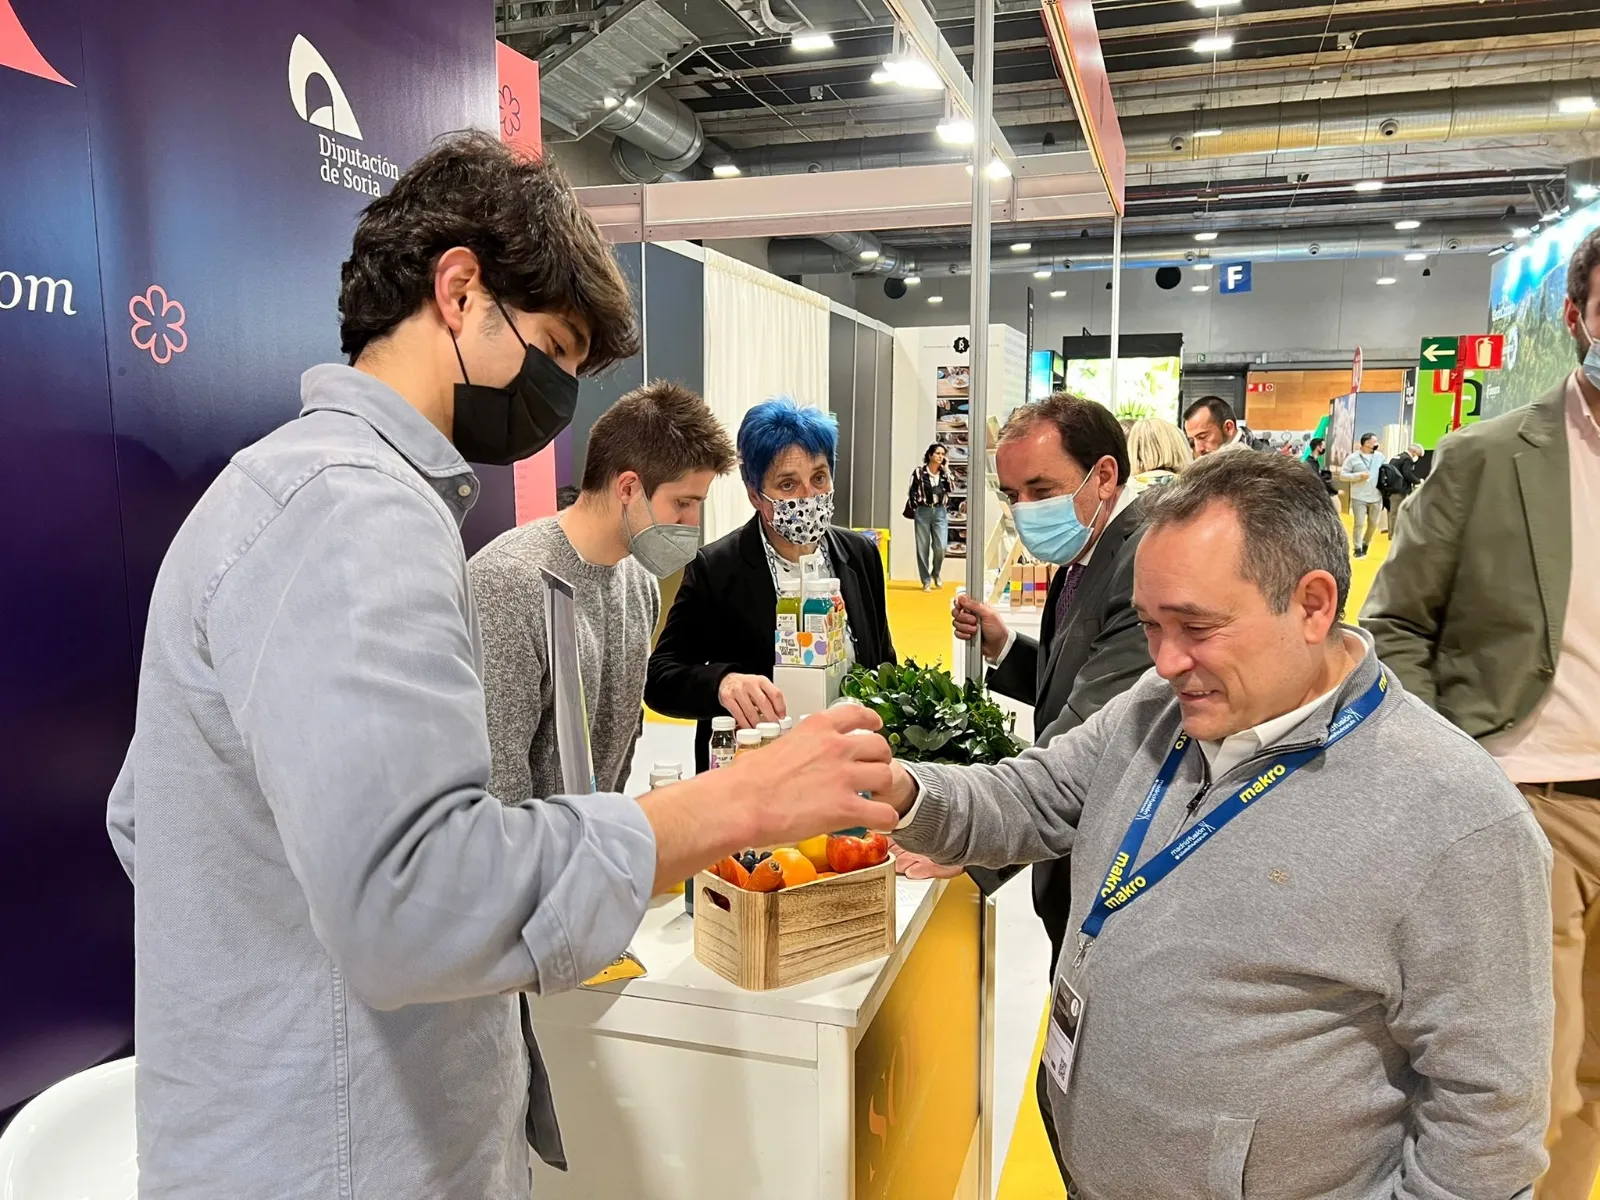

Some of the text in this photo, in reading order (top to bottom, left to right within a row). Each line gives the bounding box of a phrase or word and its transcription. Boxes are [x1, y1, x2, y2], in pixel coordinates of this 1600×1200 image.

[318, 133, 400, 181] Diputación
[320, 158, 382, 198] de Soria
[1227, 265, 1243, 290] F
[1239, 763, 1286, 804] makro
[1104, 875, 1147, 909] makro
